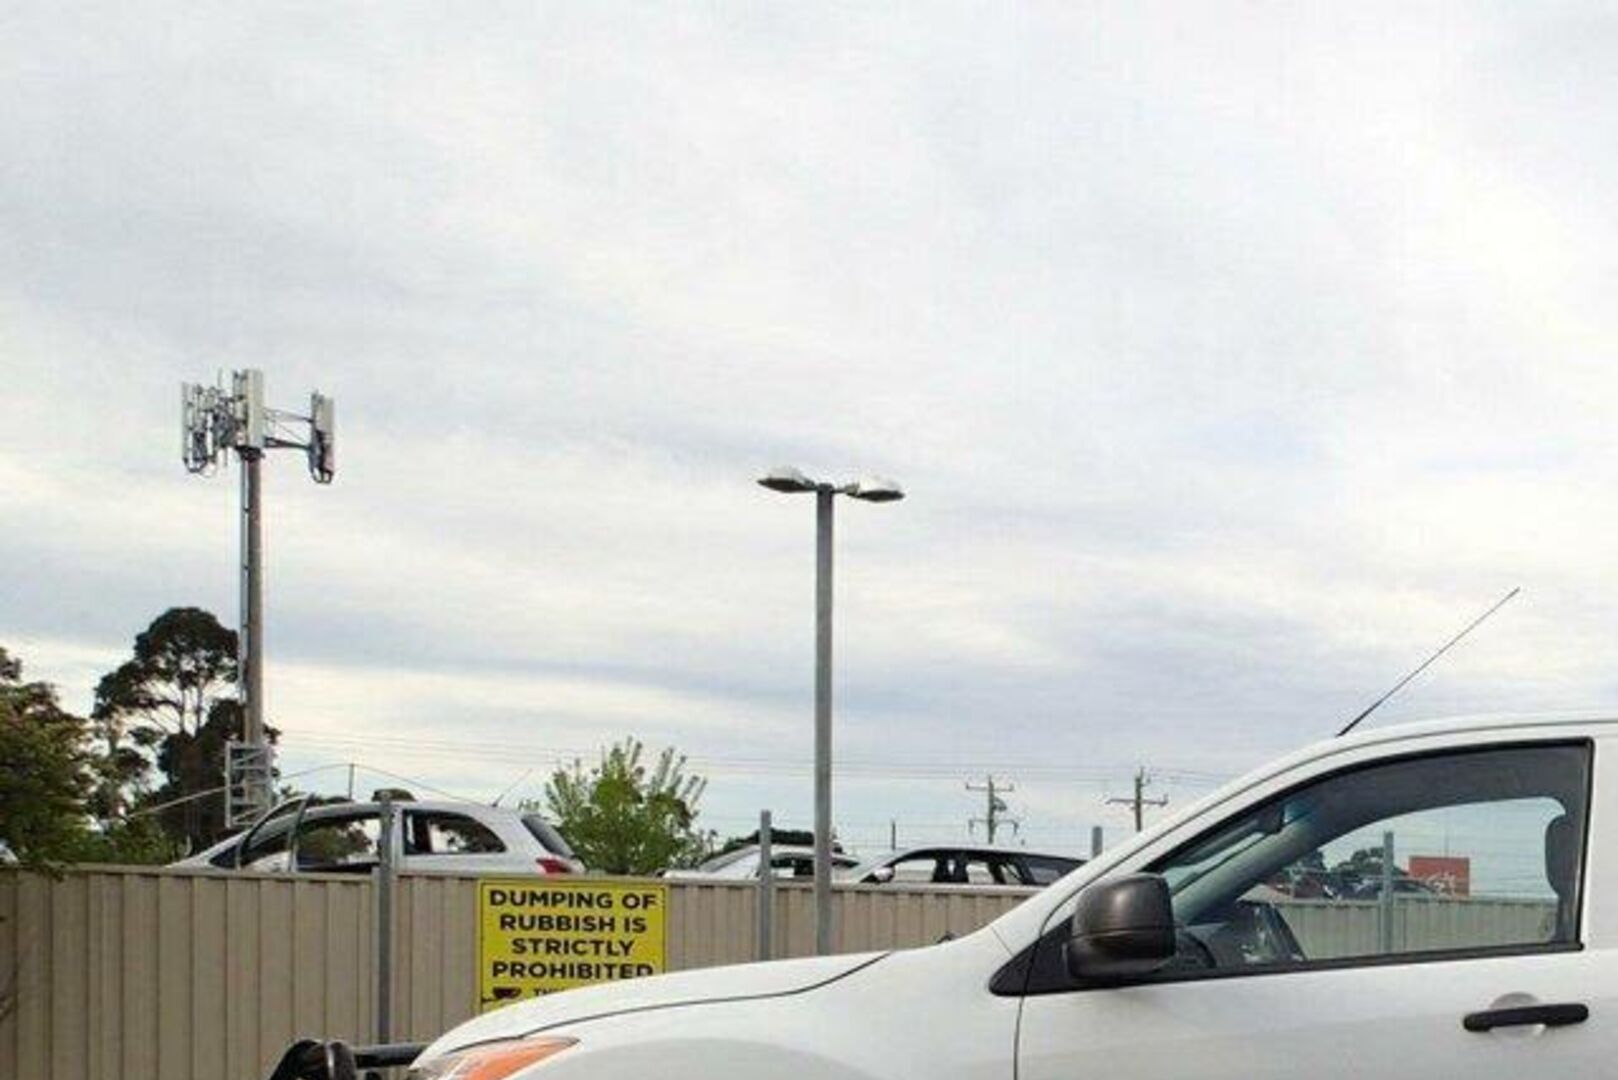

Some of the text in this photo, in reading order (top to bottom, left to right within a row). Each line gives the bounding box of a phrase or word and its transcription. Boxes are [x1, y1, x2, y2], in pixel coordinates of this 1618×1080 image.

[489, 890, 657, 909] DUMPING OF
[500, 914, 646, 933] RUBBISH IS
[512, 938, 634, 956] STRICTLY
[492, 961, 654, 979] PROHIBITED
